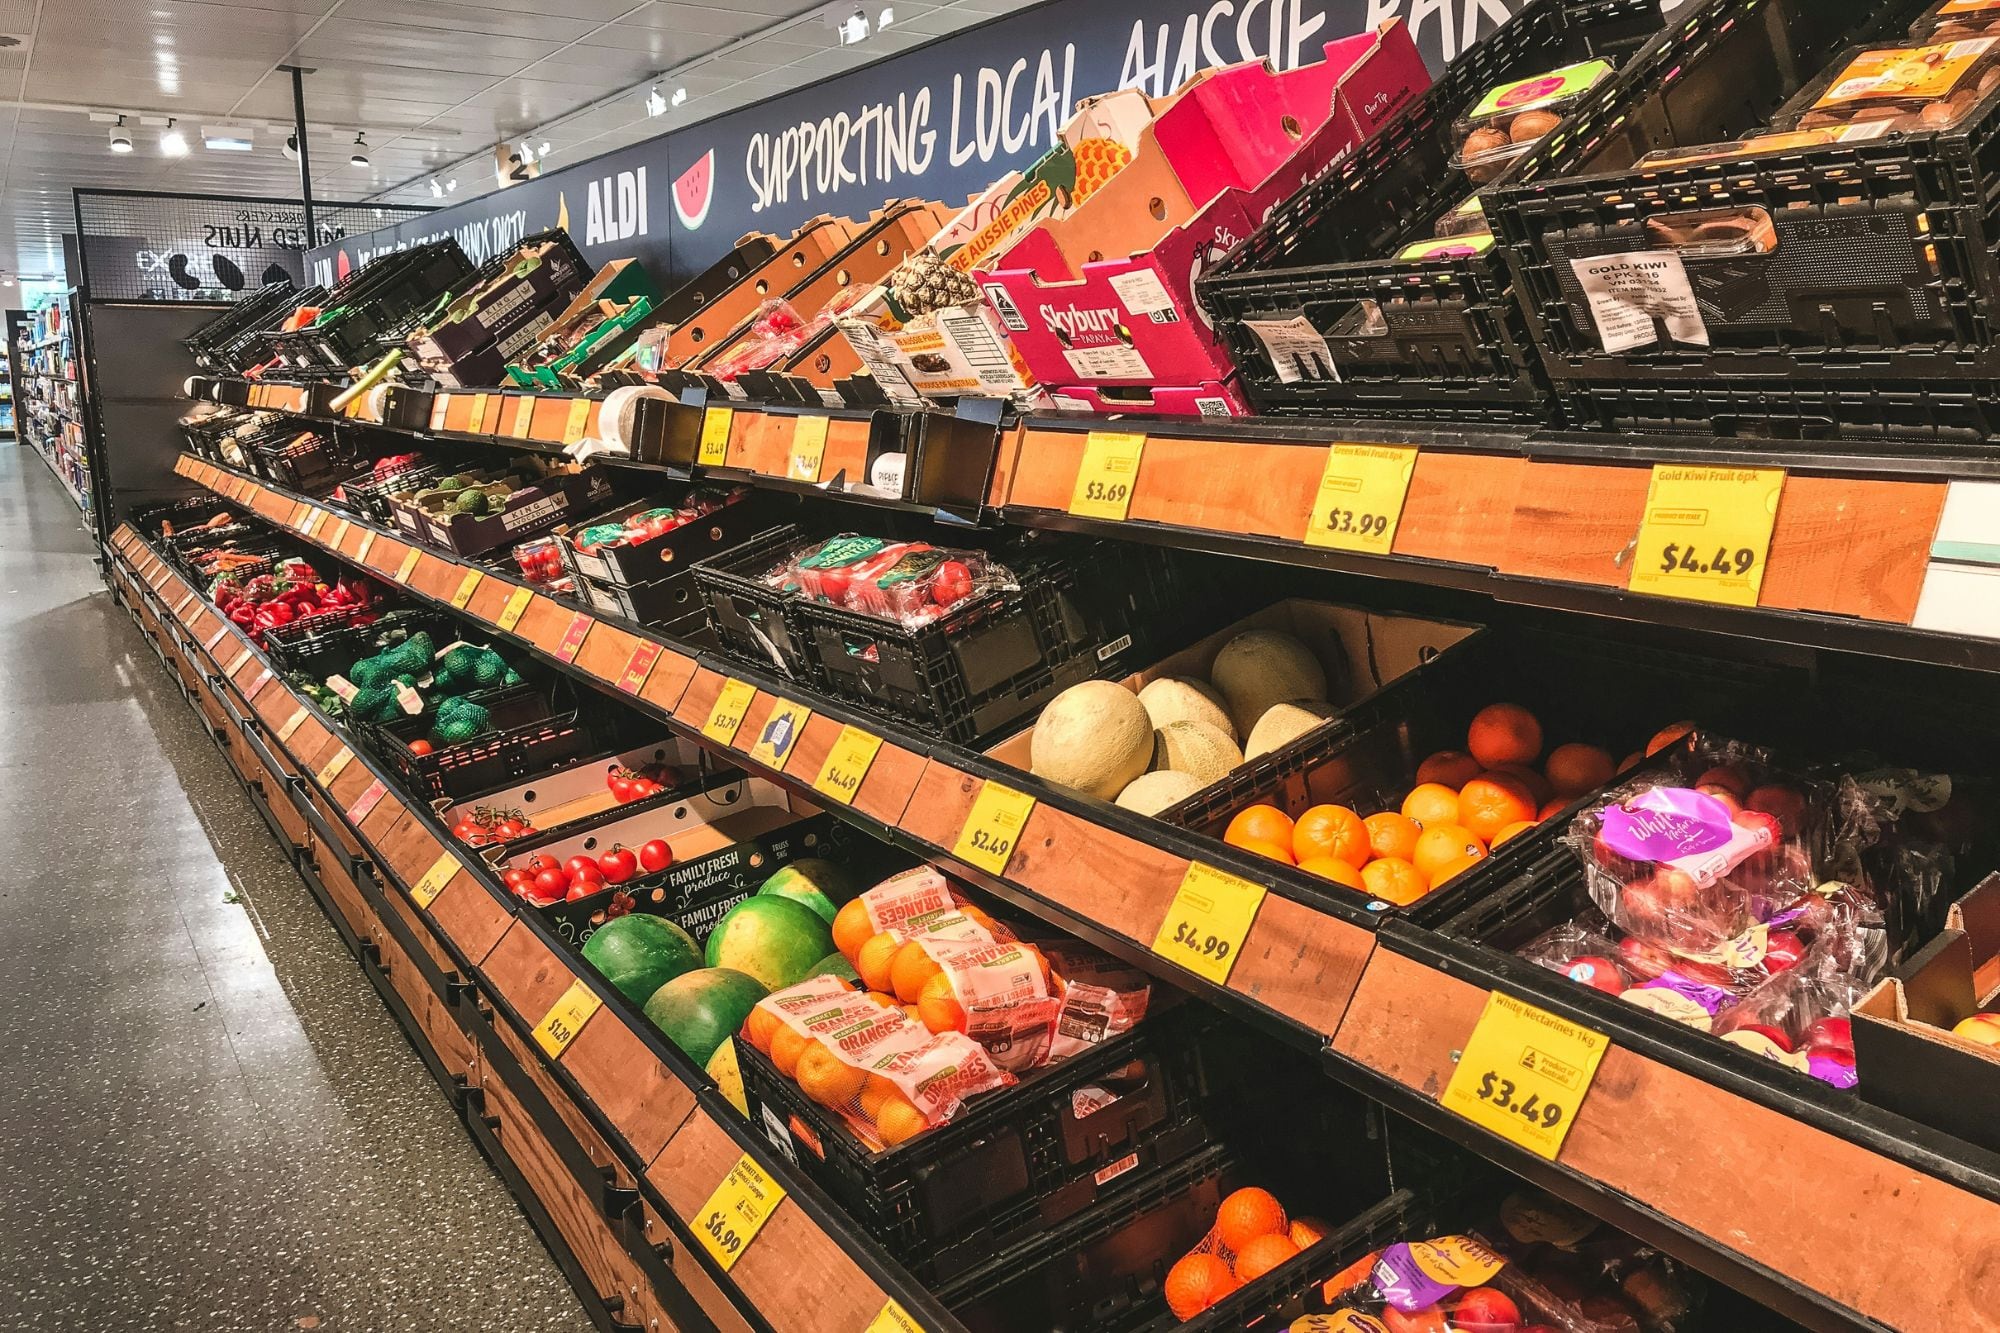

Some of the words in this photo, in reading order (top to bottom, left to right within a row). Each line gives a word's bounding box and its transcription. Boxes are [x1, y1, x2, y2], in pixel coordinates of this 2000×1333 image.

[745, 86, 937, 212] SUPPORTING
[949, 42, 1076, 168] LOCAL
[509, 154, 529, 180] 2
[585, 166, 649, 246] ALDI
[492, 210, 526, 256] DIRTY
[969, 214, 1013, 260] AUSSIE
[1011, 182, 1048, 221] PINES
[1588, 263, 1630, 275] GOLD
[1633, 261, 1668, 271] KIWI
[1615, 271, 1633, 279] PK
[1646, 271, 1660, 279] 16
[485, 296, 511, 315] KING
[1039, 302, 1121, 338] Skybury
[505, 328, 530, 346] KING
[1080, 333, 1113, 344] PAPAYA
[705, 443, 724, 455] $3.49
[1333, 446, 1354, 455] Green
[1354, 448, 1370, 457] Kiwi
[1371, 449, 1389, 458] Fruit
[1658, 470, 1682, 481] Gold
[1683, 470, 1707, 481] Kiwi
[1708, 472, 1735, 481] Fruit
[1736, 472, 1760, 484] 6pk
[1086, 480, 1127, 501] $3.69
[511, 502, 541, 518] KING
[512, 509, 546, 526] AVOCADO
[1327, 507, 1388, 537] $3.99
[1660, 543, 1755, 576] $4.49
[713, 713, 737, 730] $3.79
[826, 766, 857, 790] $4.49
[970, 829, 1009, 857] $2.49
[670, 862, 707, 887] FAMILY
[707, 851, 740, 874] FRESH
[1210, 868, 1238, 887] Oranges
[684, 870, 731, 899] produce
[681, 903, 717, 929] FAMILY
[876, 895, 944, 926] ORANGES
[1173, 920, 1230, 961] $4.99
[547, 1017, 571, 1044] $1.29
[1496, 995, 1522, 1014] White
[1523, 1006, 1575, 1038] Nectarines
[1576, 1030, 1597, 1048] 1kg
[838, 1018, 905, 1052] ORANGES
[1539, 1065, 1570, 1085] Australia
[1541, 1056, 1567, 1074] Product
[1476, 1070, 1563, 1129] $3.49
[741, 1160, 756, 1178] MARKET
[753, 1172, 764, 1184] BUY
[748, 1182, 765, 1201] Oranges
[705, 1210, 741, 1254] $6.99
[888, 1305, 902, 1324] Navel
